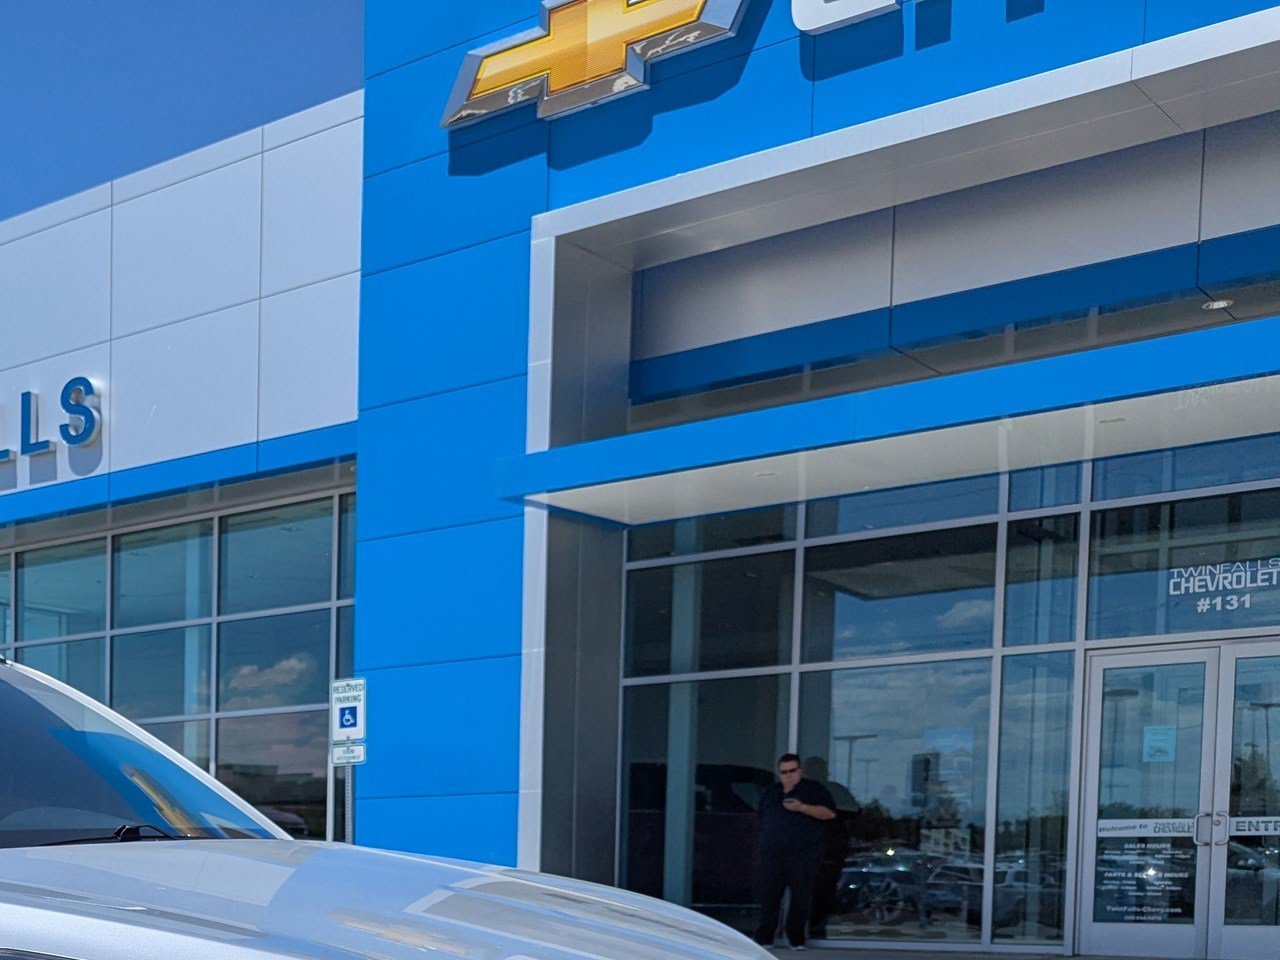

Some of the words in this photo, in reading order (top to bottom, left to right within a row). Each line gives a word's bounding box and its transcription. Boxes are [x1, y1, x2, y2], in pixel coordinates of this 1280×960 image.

[1169, 568, 1280, 595] CHEVROLET
[1196, 593, 1252, 613] #131
[333, 684, 363, 694] RESERVED
[335, 695, 361, 703] PARKING
